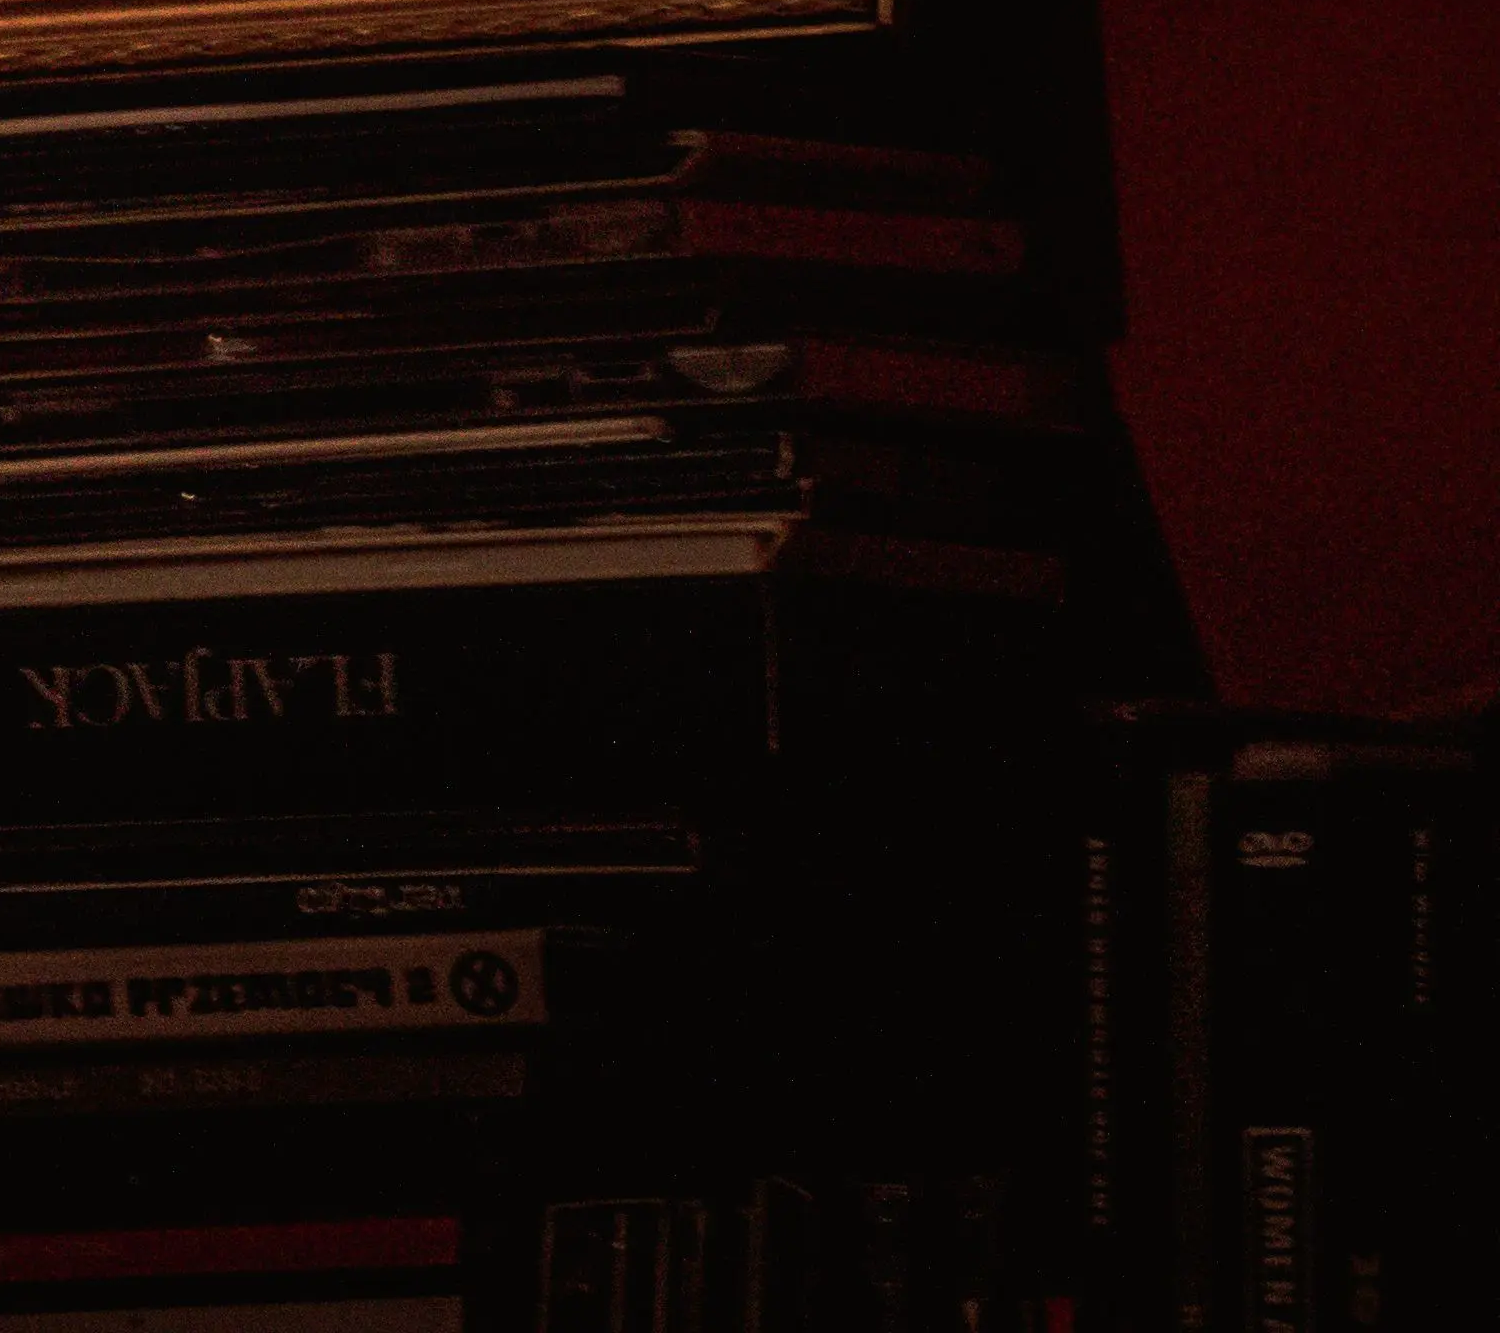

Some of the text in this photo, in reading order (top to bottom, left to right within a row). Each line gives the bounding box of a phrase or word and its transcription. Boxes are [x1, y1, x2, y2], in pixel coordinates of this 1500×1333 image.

[17, 645, 399, 731] FLAPJACK
[127, 969, 394, 1021] PRZEMOCY
[1257, 1142, 1300, 1309] WOMEN
